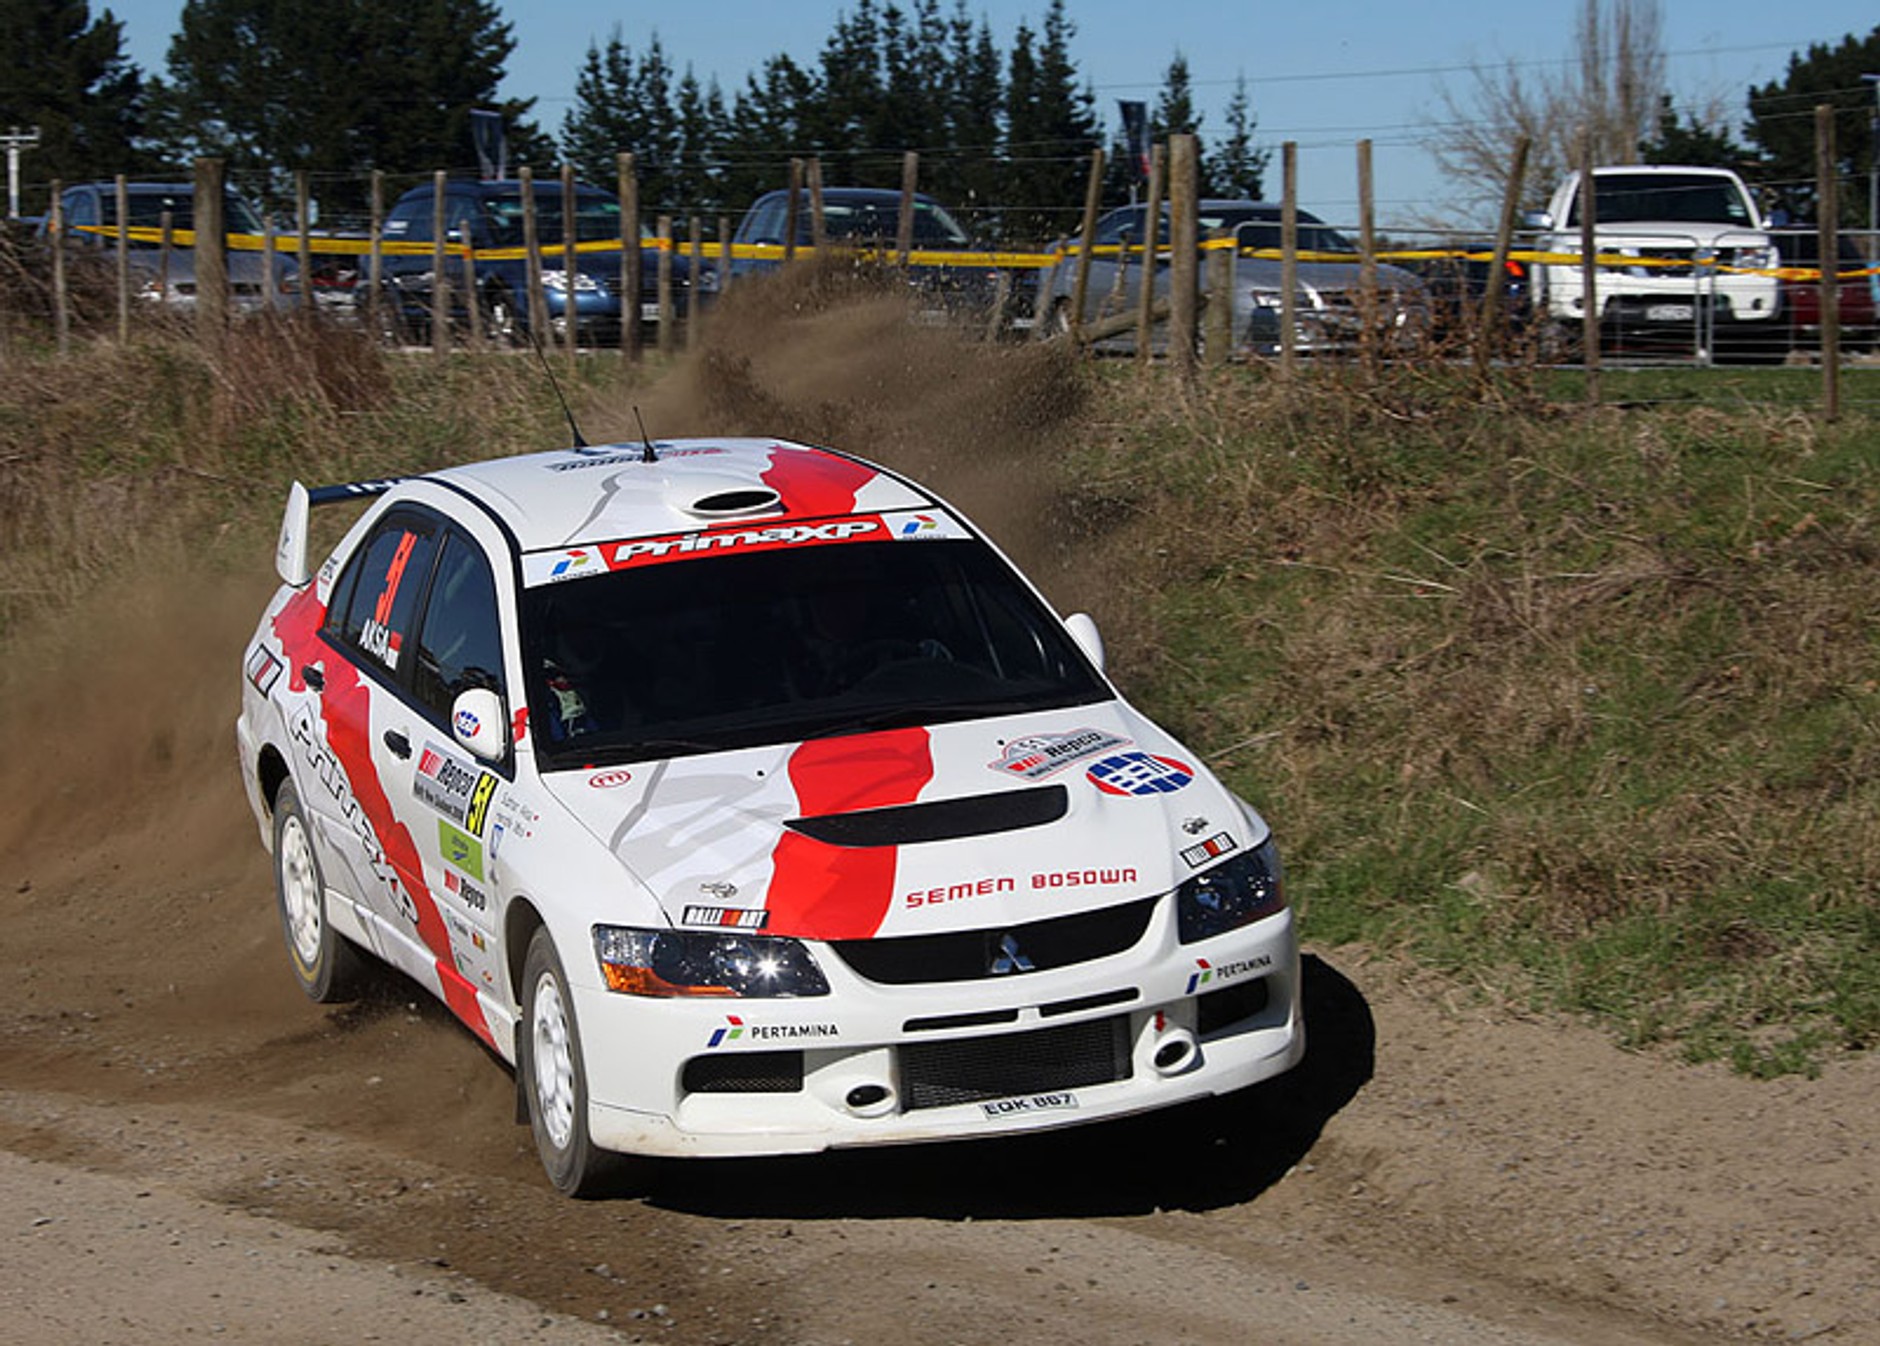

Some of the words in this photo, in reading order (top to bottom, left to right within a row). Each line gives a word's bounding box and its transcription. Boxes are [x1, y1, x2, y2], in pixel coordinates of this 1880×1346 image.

[1044, 732, 1103, 758] Repco
[437, 758, 475, 797] Repco
[905, 877, 1015, 909] SEMEN
[1031, 867, 1138, 890] BOSOWA
[1217, 954, 1272, 979] PERTAMINA
[751, 1024, 839, 1040] PERTAMINA
